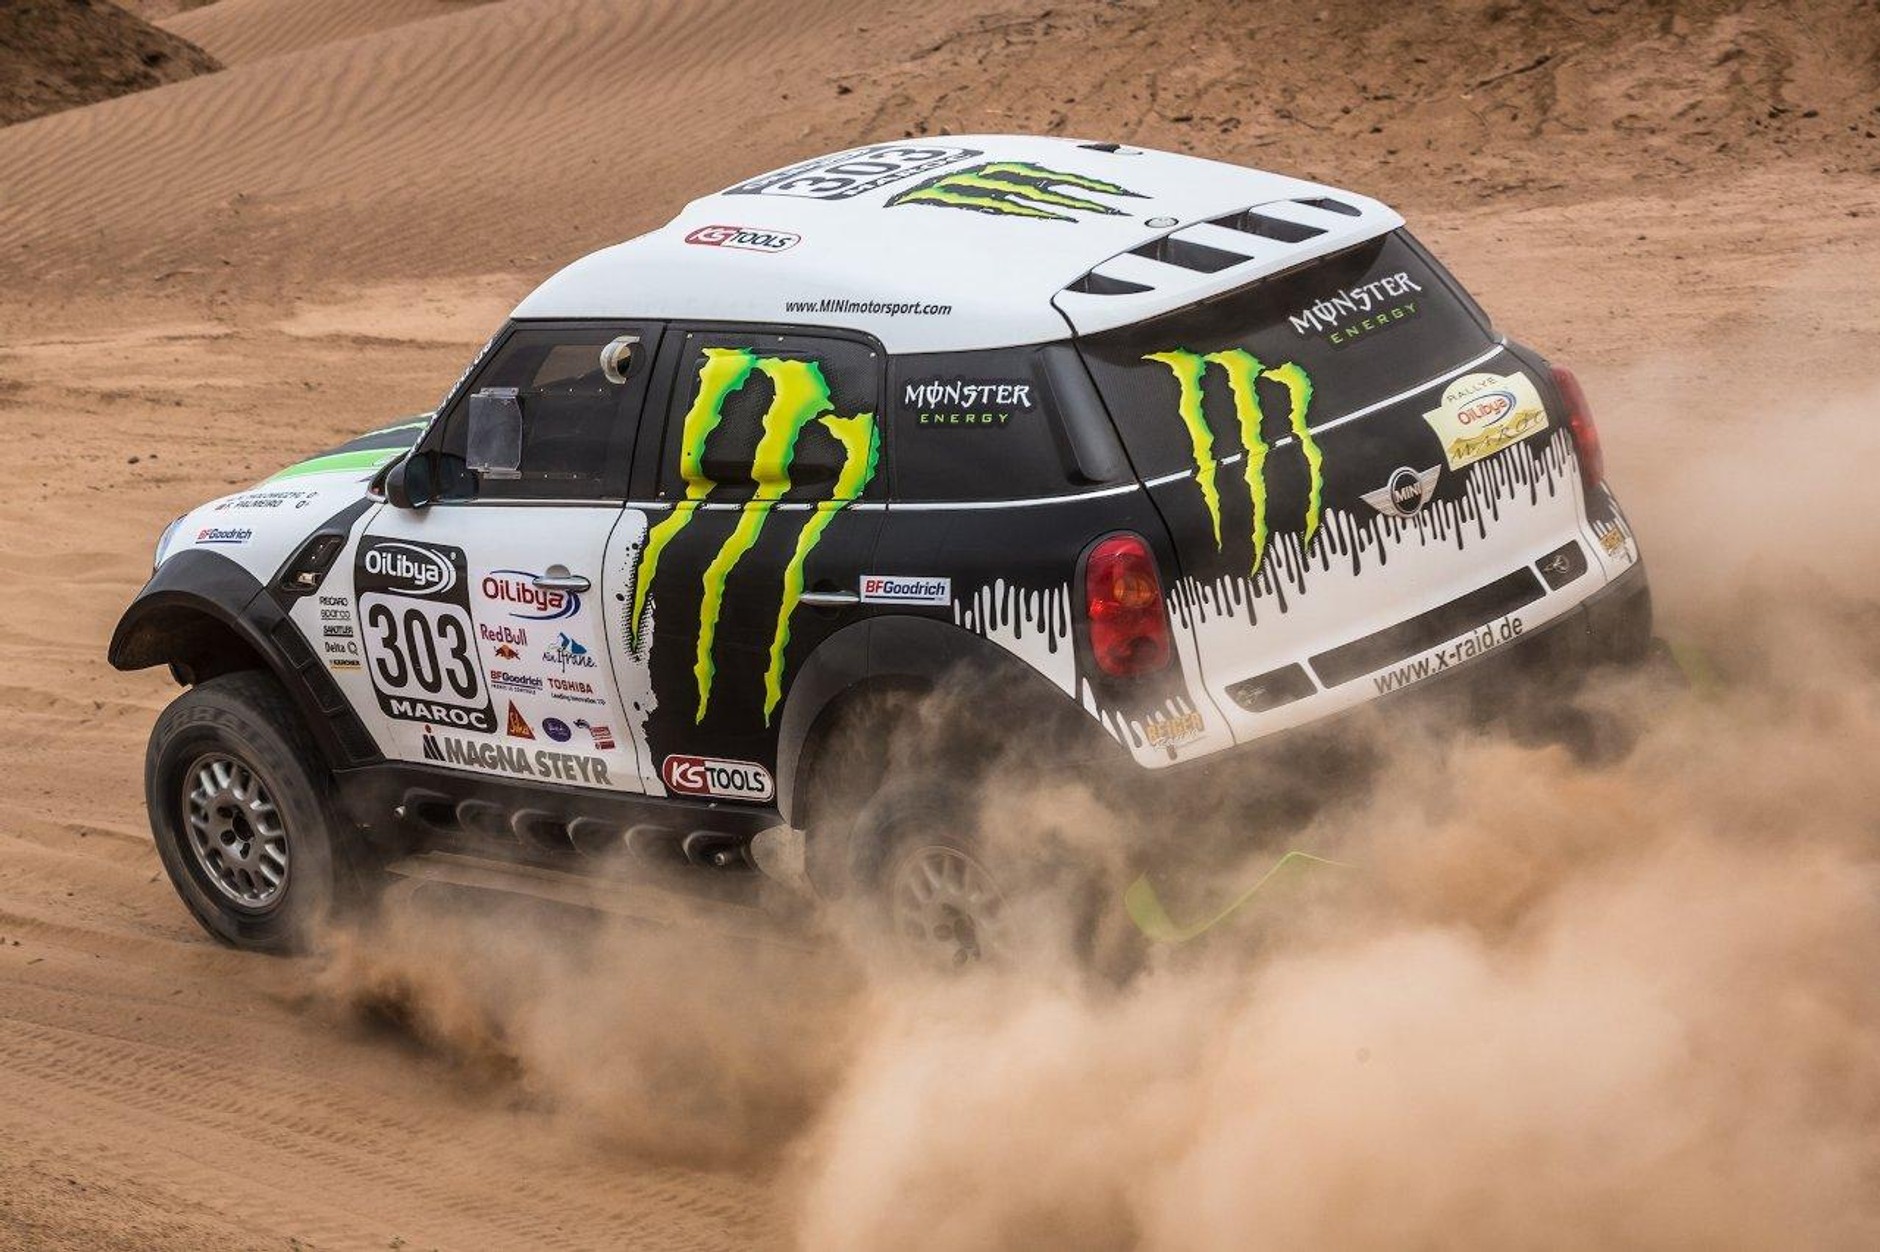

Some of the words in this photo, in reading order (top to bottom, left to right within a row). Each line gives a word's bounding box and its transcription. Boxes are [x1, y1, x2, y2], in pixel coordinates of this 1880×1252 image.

[778, 149, 948, 192] 303
[730, 229, 791, 248] TOOLS
[785, 299, 953, 317] www.MINImotorsport.com
[1288, 272, 1422, 335] MONSTER
[1330, 303, 1417, 344] ENERGY
[904, 380, 1032, 409] MONSTER
[920, 413, 1008, 423] ENERGY
[1393, 481, 1422, 504] MINI
[197, 528, 253, 540] BFGoodrich
[365, 550, 440, 586] OiLibya
[482, 577, 565, 611] OiLibya
[865, 579, 945, 596] BFGoodrich
[325, 642, 346, 653] Delta
[480, 623, 502, 641] Red
[503, 626, 528, 646] Bull
[369, 603, 478, 699] 303
[1373, 615, 1523, 694] www.x-raid.de
[490, 670, 543, 687] BFGoodrich
[547, 678, 594, 694] TOSHIBA
[390, 700, 488, 728] MAROC
[444, 736, 536, 776] MAGNA
[534, 749, 613, 786] STEYR
[671, 761, 706, 788] KS
[704, 766, 765, 792] TOOLS
